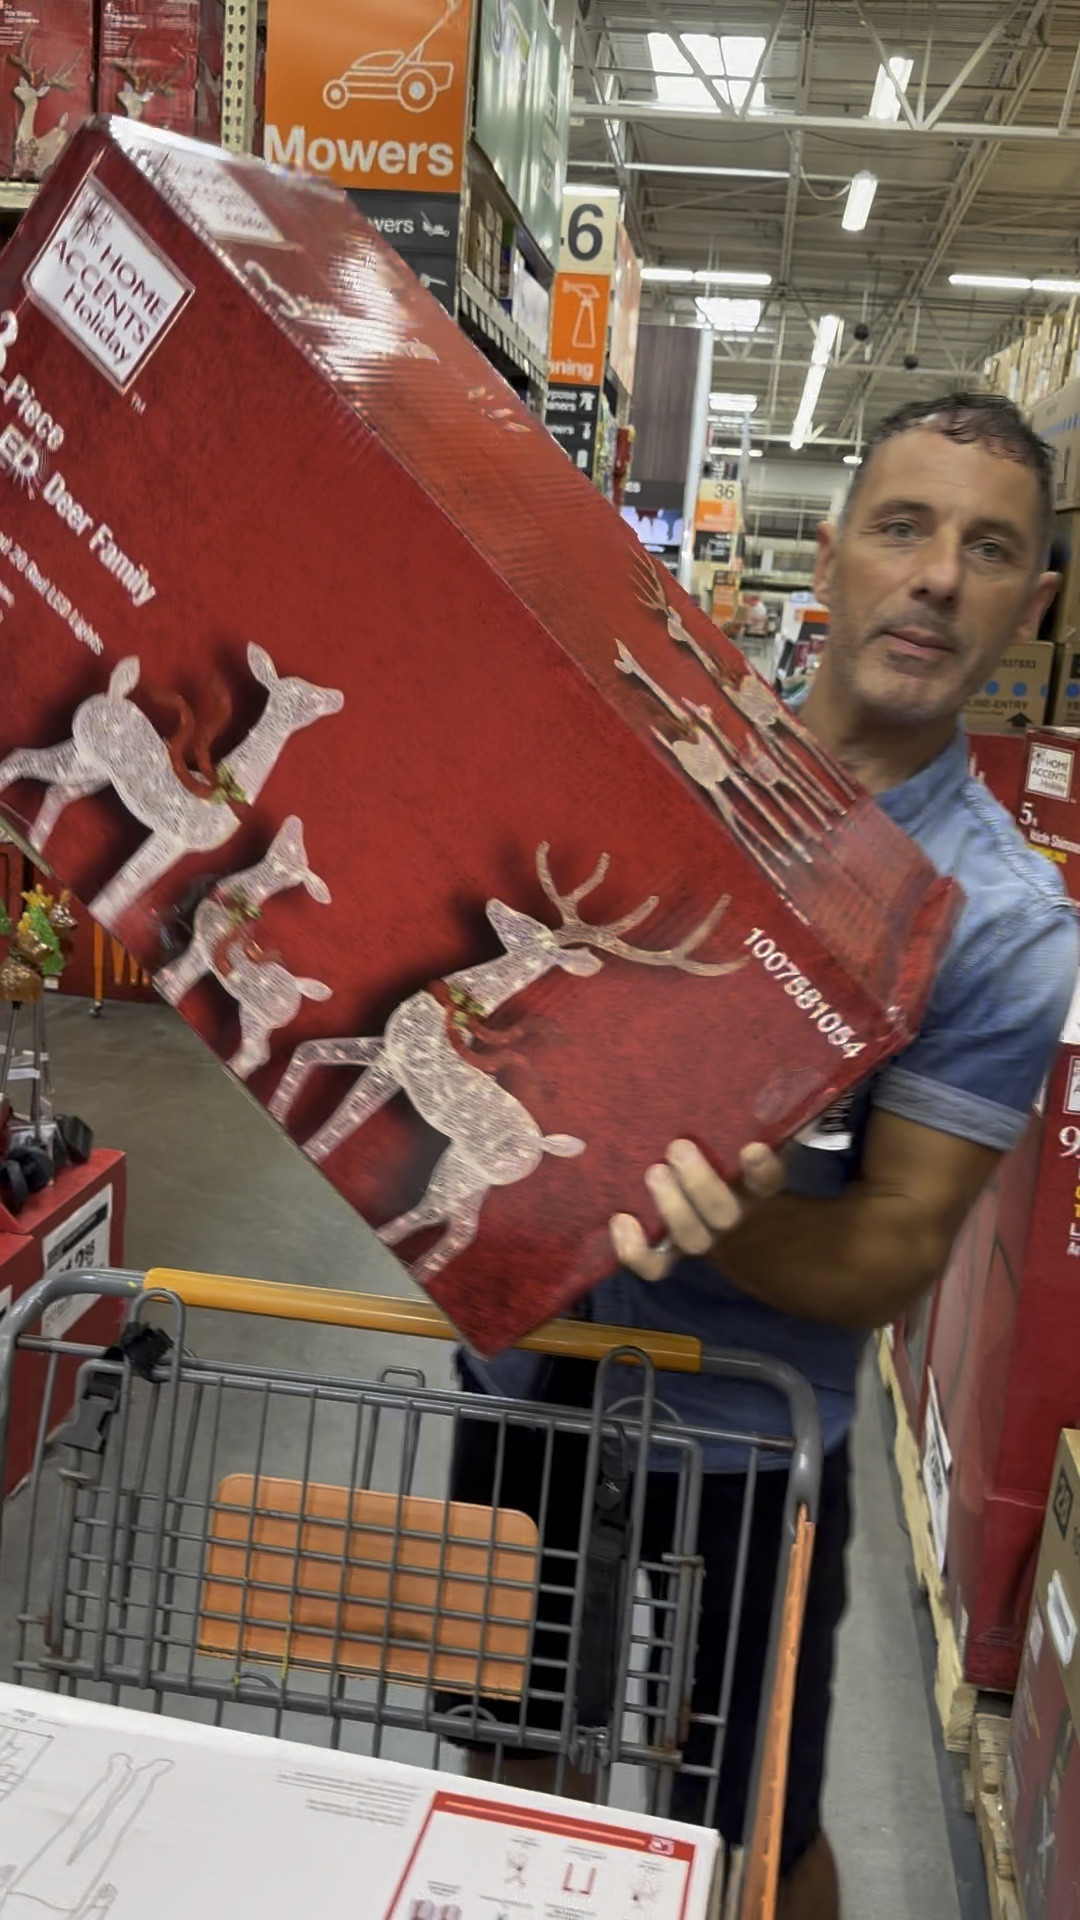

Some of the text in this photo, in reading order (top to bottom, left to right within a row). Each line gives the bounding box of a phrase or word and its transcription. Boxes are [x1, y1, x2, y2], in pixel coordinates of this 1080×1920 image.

[264, 124, 454, 177] Mowers
[367, 216, 414, 234] wers
[561, 203, 604, 261] 6
[53, 238, 151, 346] ACCENTS
[100, 243, 170, 322] HOME
[63, 282, 131, 365] Holiday
[547, 358, 594, 382] ning
[714, 483, 735, 499] 36
[43, 470, 94, 537] Deer
[89, 522, 157, 608] Family
